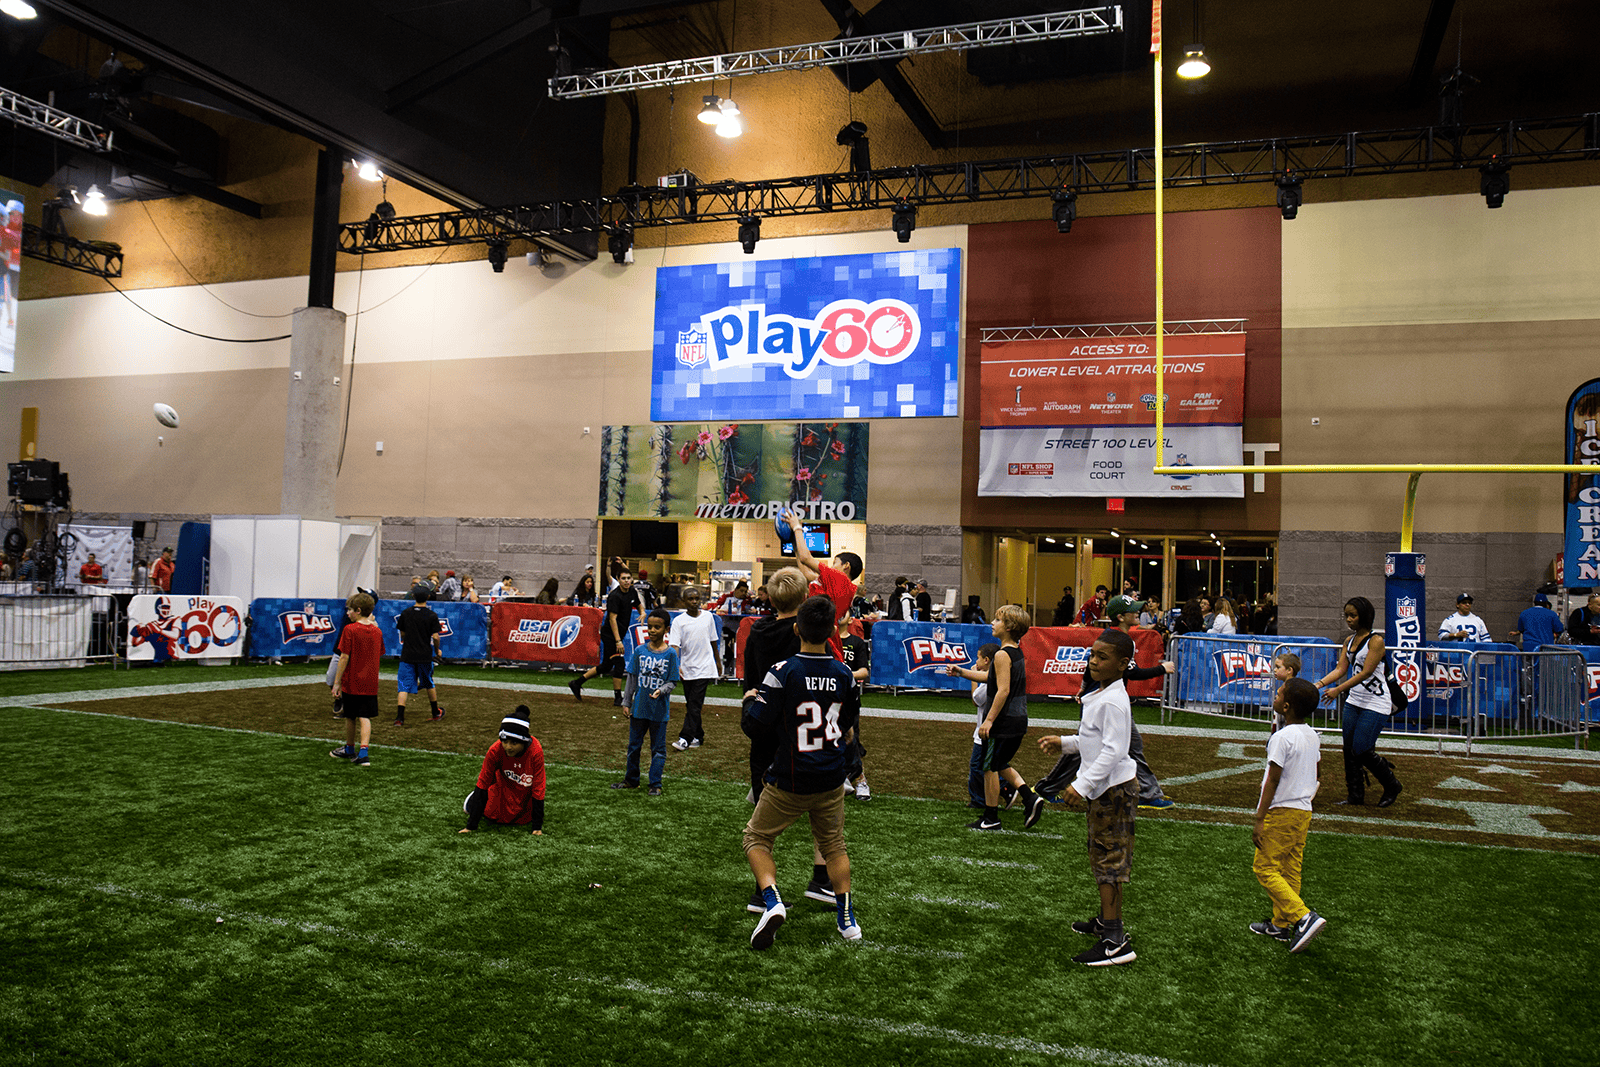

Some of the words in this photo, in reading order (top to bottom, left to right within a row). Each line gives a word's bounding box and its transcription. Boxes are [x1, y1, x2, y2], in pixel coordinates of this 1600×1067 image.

[1070, 345, 1125, 356] ACCESS
[1127, 344, 1150, 354] TO:
[1009, 366, 1058, 377] LOWER
[1060, 365, 1102, 376] LEVEL
[1044, 439, 1100, 449] STREET
[1102, 439, 1127, 449] 100
[1093, 461, 1123, 469] FOOD
[1090, 471, 1126, 480] COURT
[188, 596, 216, 614] play
[1399, 606, 1415, 617] NFL
[177, 604, 242, 655] 60
[285, 613, 332, 635] FLAG
[518, 619, 552, 633] USA
[508, 630, 549, 645] Football
[911, 639, 967, 664] FLAG
[1043, 660, 1088, 675] Footba
[1222, 652, 1272, 678] FLA
[1426, 664, 1466, 684] LAG
[804, 676, 838, 691] REVIS
[797, 700, 843, 752] 24
